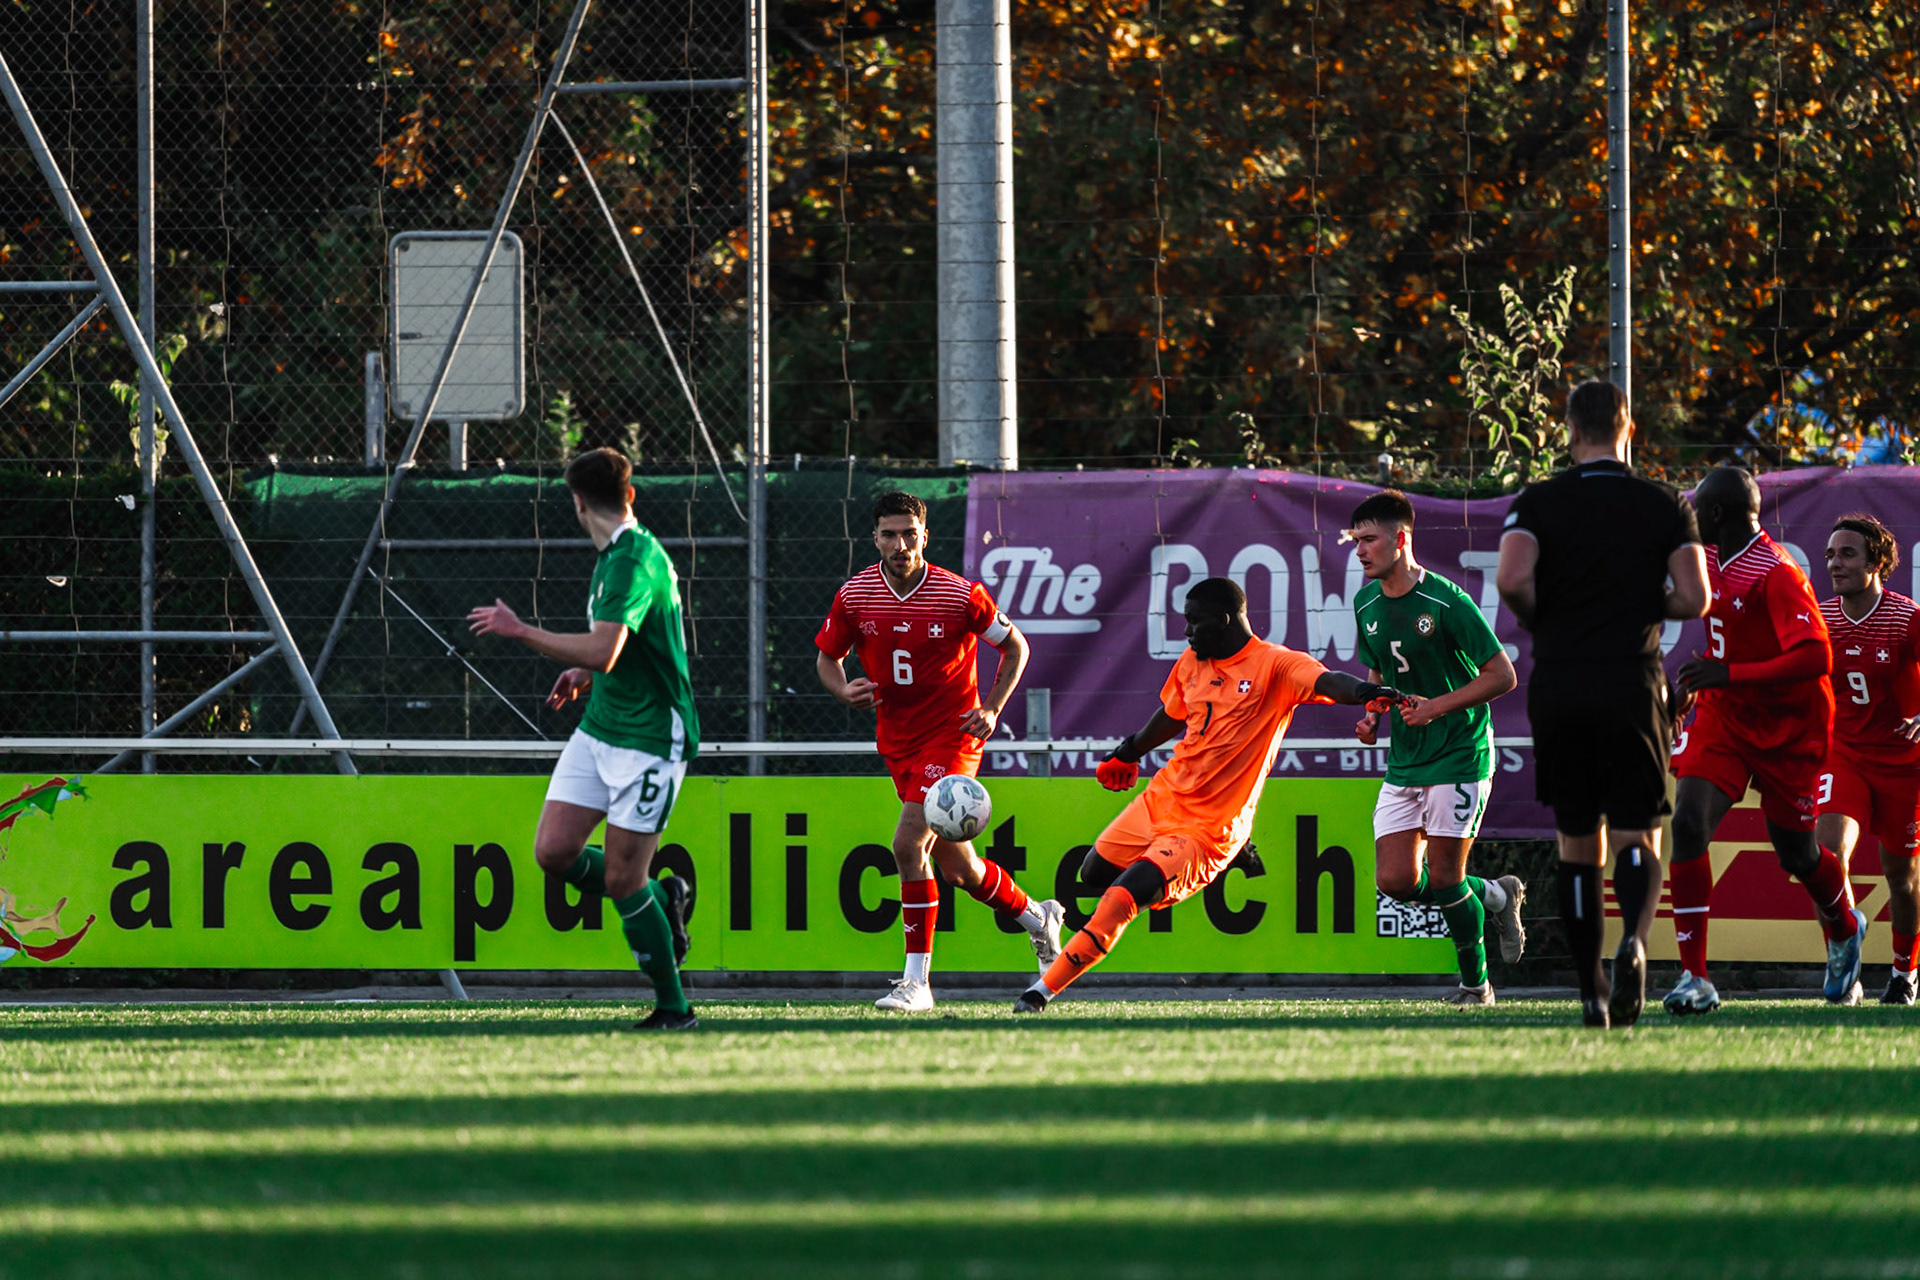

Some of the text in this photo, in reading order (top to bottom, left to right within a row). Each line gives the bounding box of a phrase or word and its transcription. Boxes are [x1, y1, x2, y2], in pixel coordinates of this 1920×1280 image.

[980, 546, 1101, 615] The
[1710, 616, 1725, 659] 5
[892, 649, 914, 685] 6
[1390, 641, 1410, 673] 5
[1847, 671, 1871, 704] 9
[639, 768, 660, 803] 6
